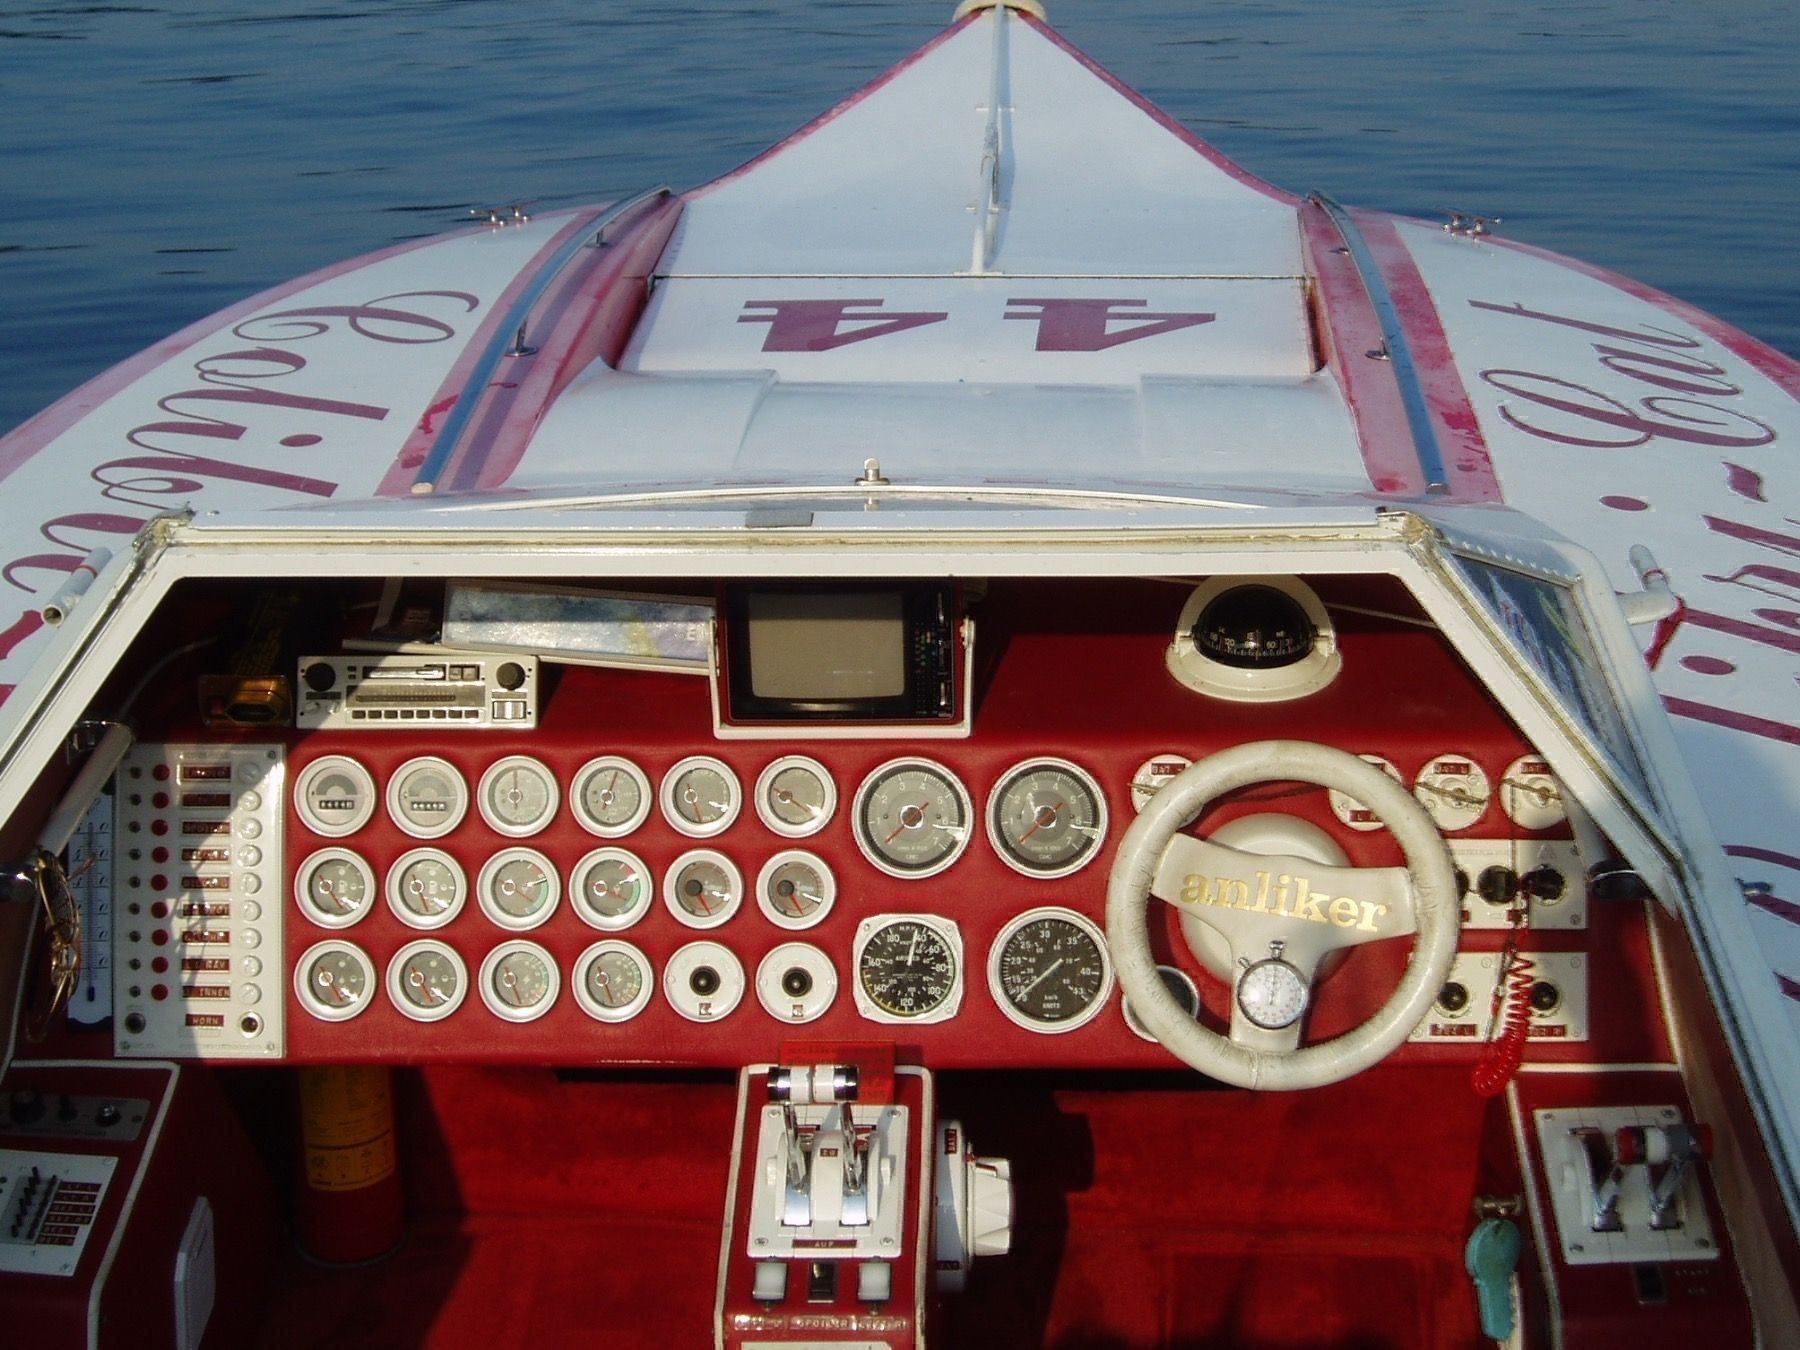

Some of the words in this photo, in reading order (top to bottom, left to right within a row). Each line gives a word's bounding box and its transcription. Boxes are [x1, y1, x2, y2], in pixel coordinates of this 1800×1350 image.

[737, 298, 1215, 352] 44
[1180, 871, 1387, 932] anliker
[1021, 941, 1031, 949] 25
[192, 1016, 219, 1025] HORN
